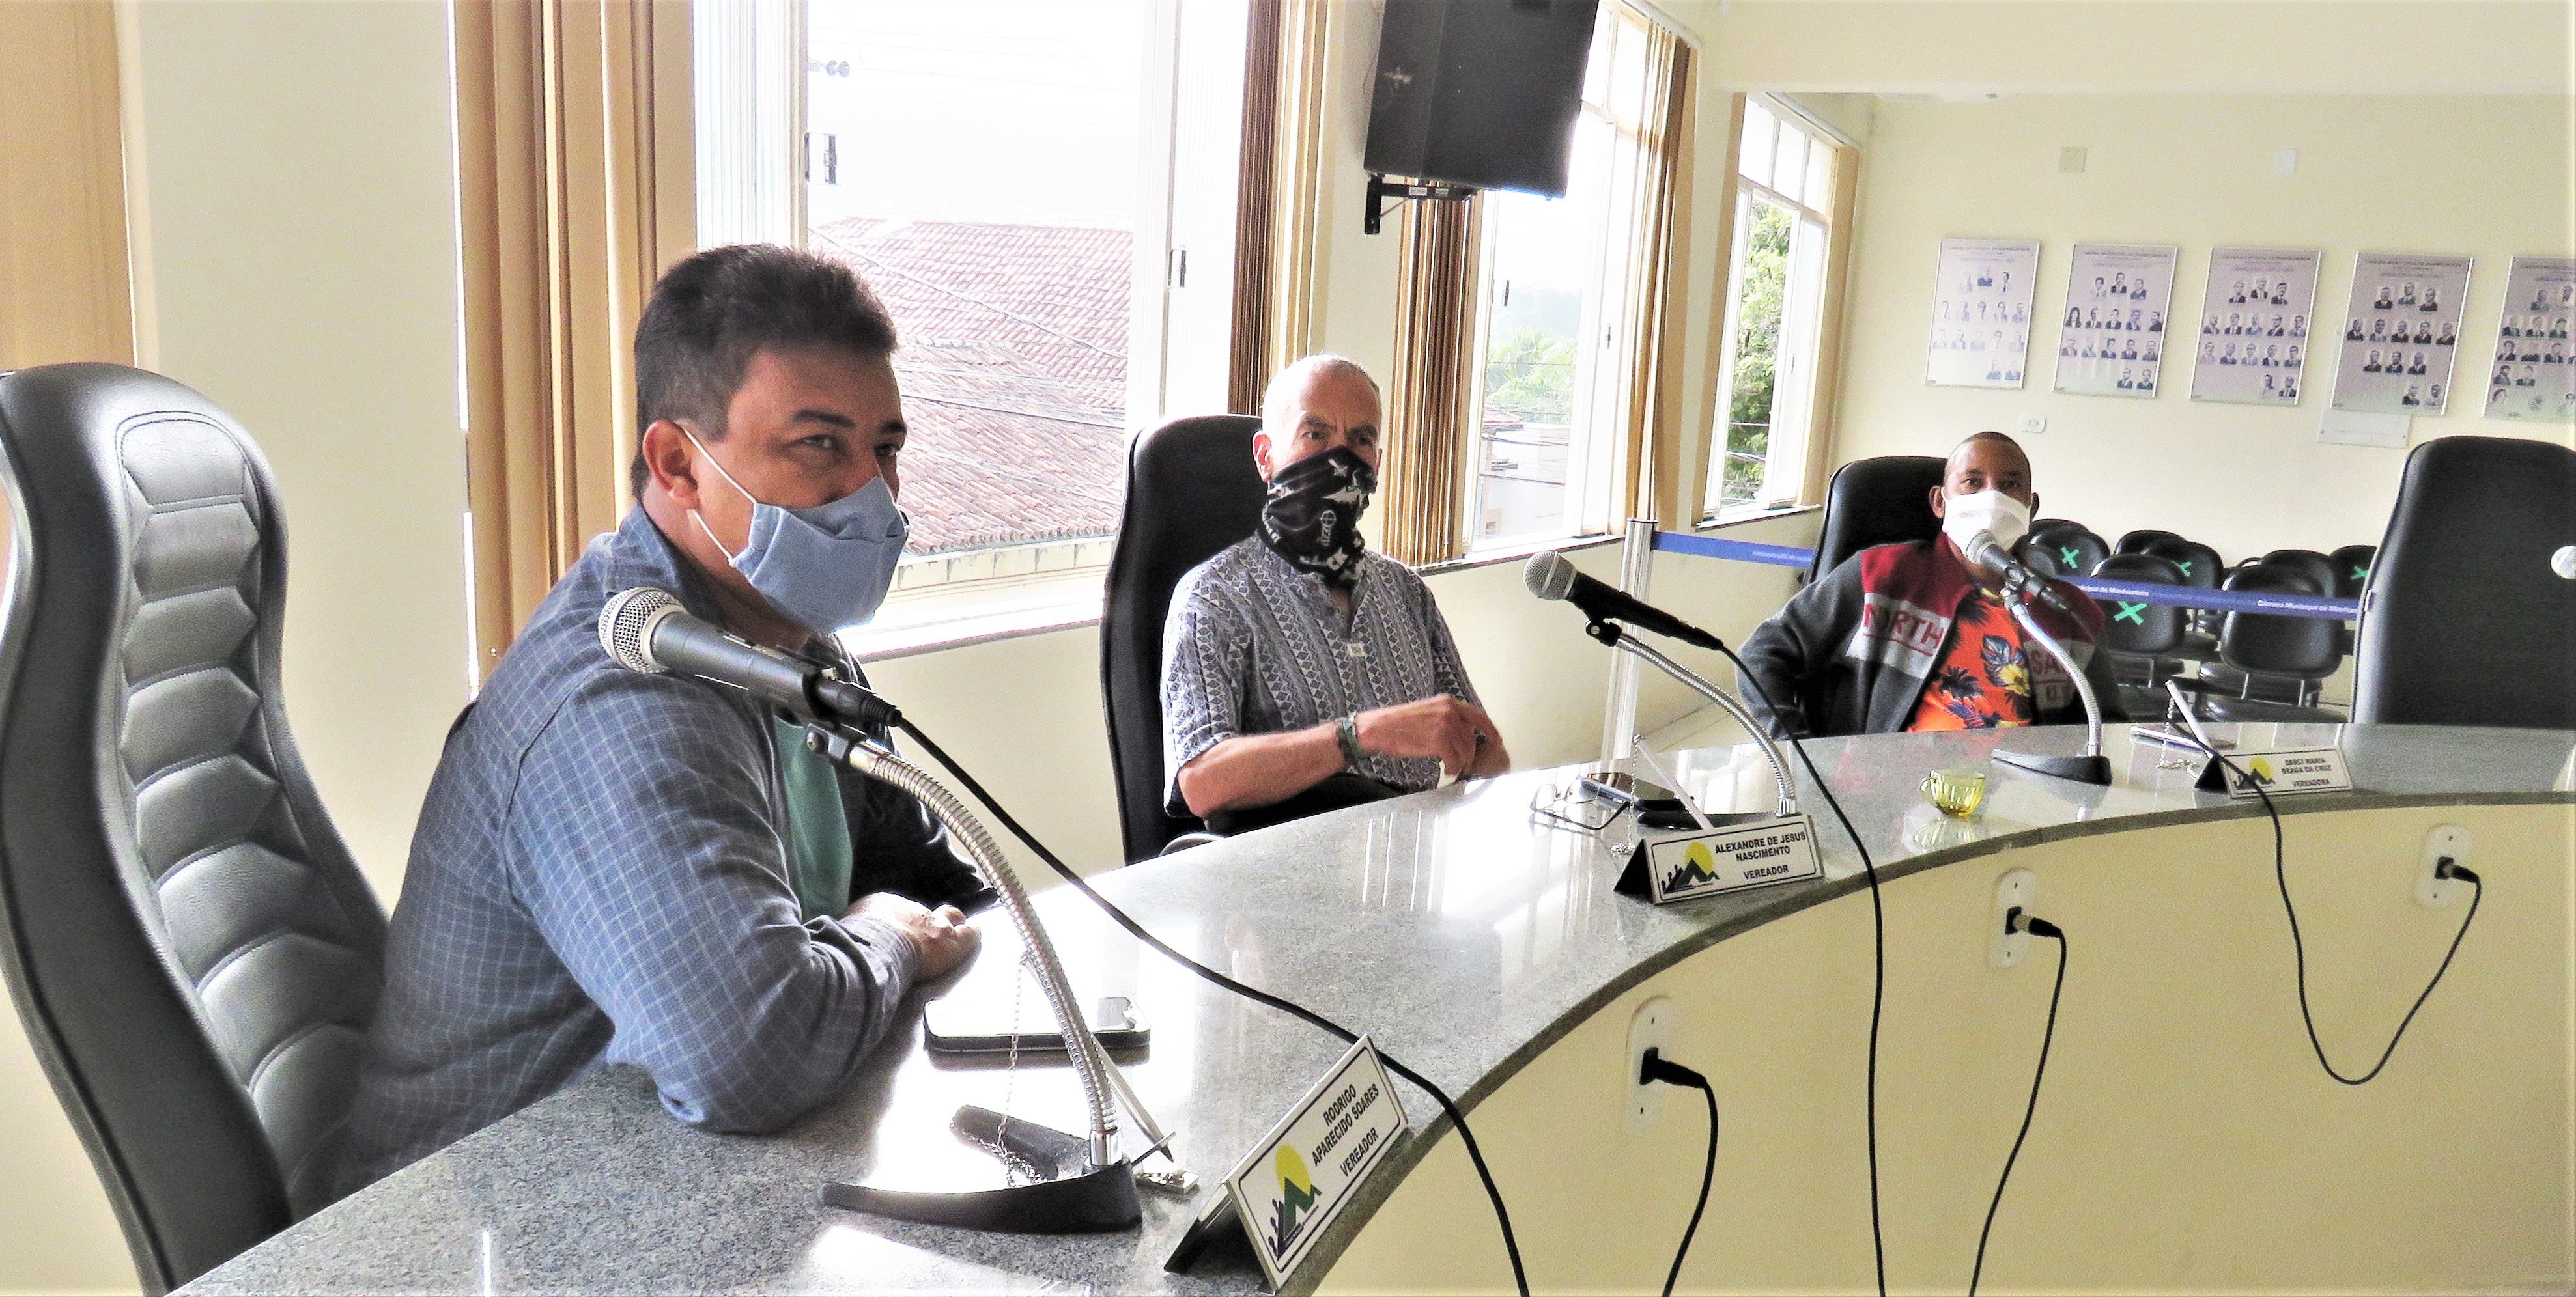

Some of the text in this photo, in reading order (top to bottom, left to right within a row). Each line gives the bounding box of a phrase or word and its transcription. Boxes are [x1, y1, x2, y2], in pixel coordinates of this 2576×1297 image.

[1715, 831, 1806, 854] ALEXANDRE DE JESUS
[1735, 846, 1790, 862] NASCIMENTO
[1743, 865, 1789, 880] VEREADOR
[1323, 1083, 1357, 1126] RODRIGO
[1312, 1083, 1380, 1167] APARECIDO SOARES
[1339, 1127, 1380, 1177] VEREADOR
